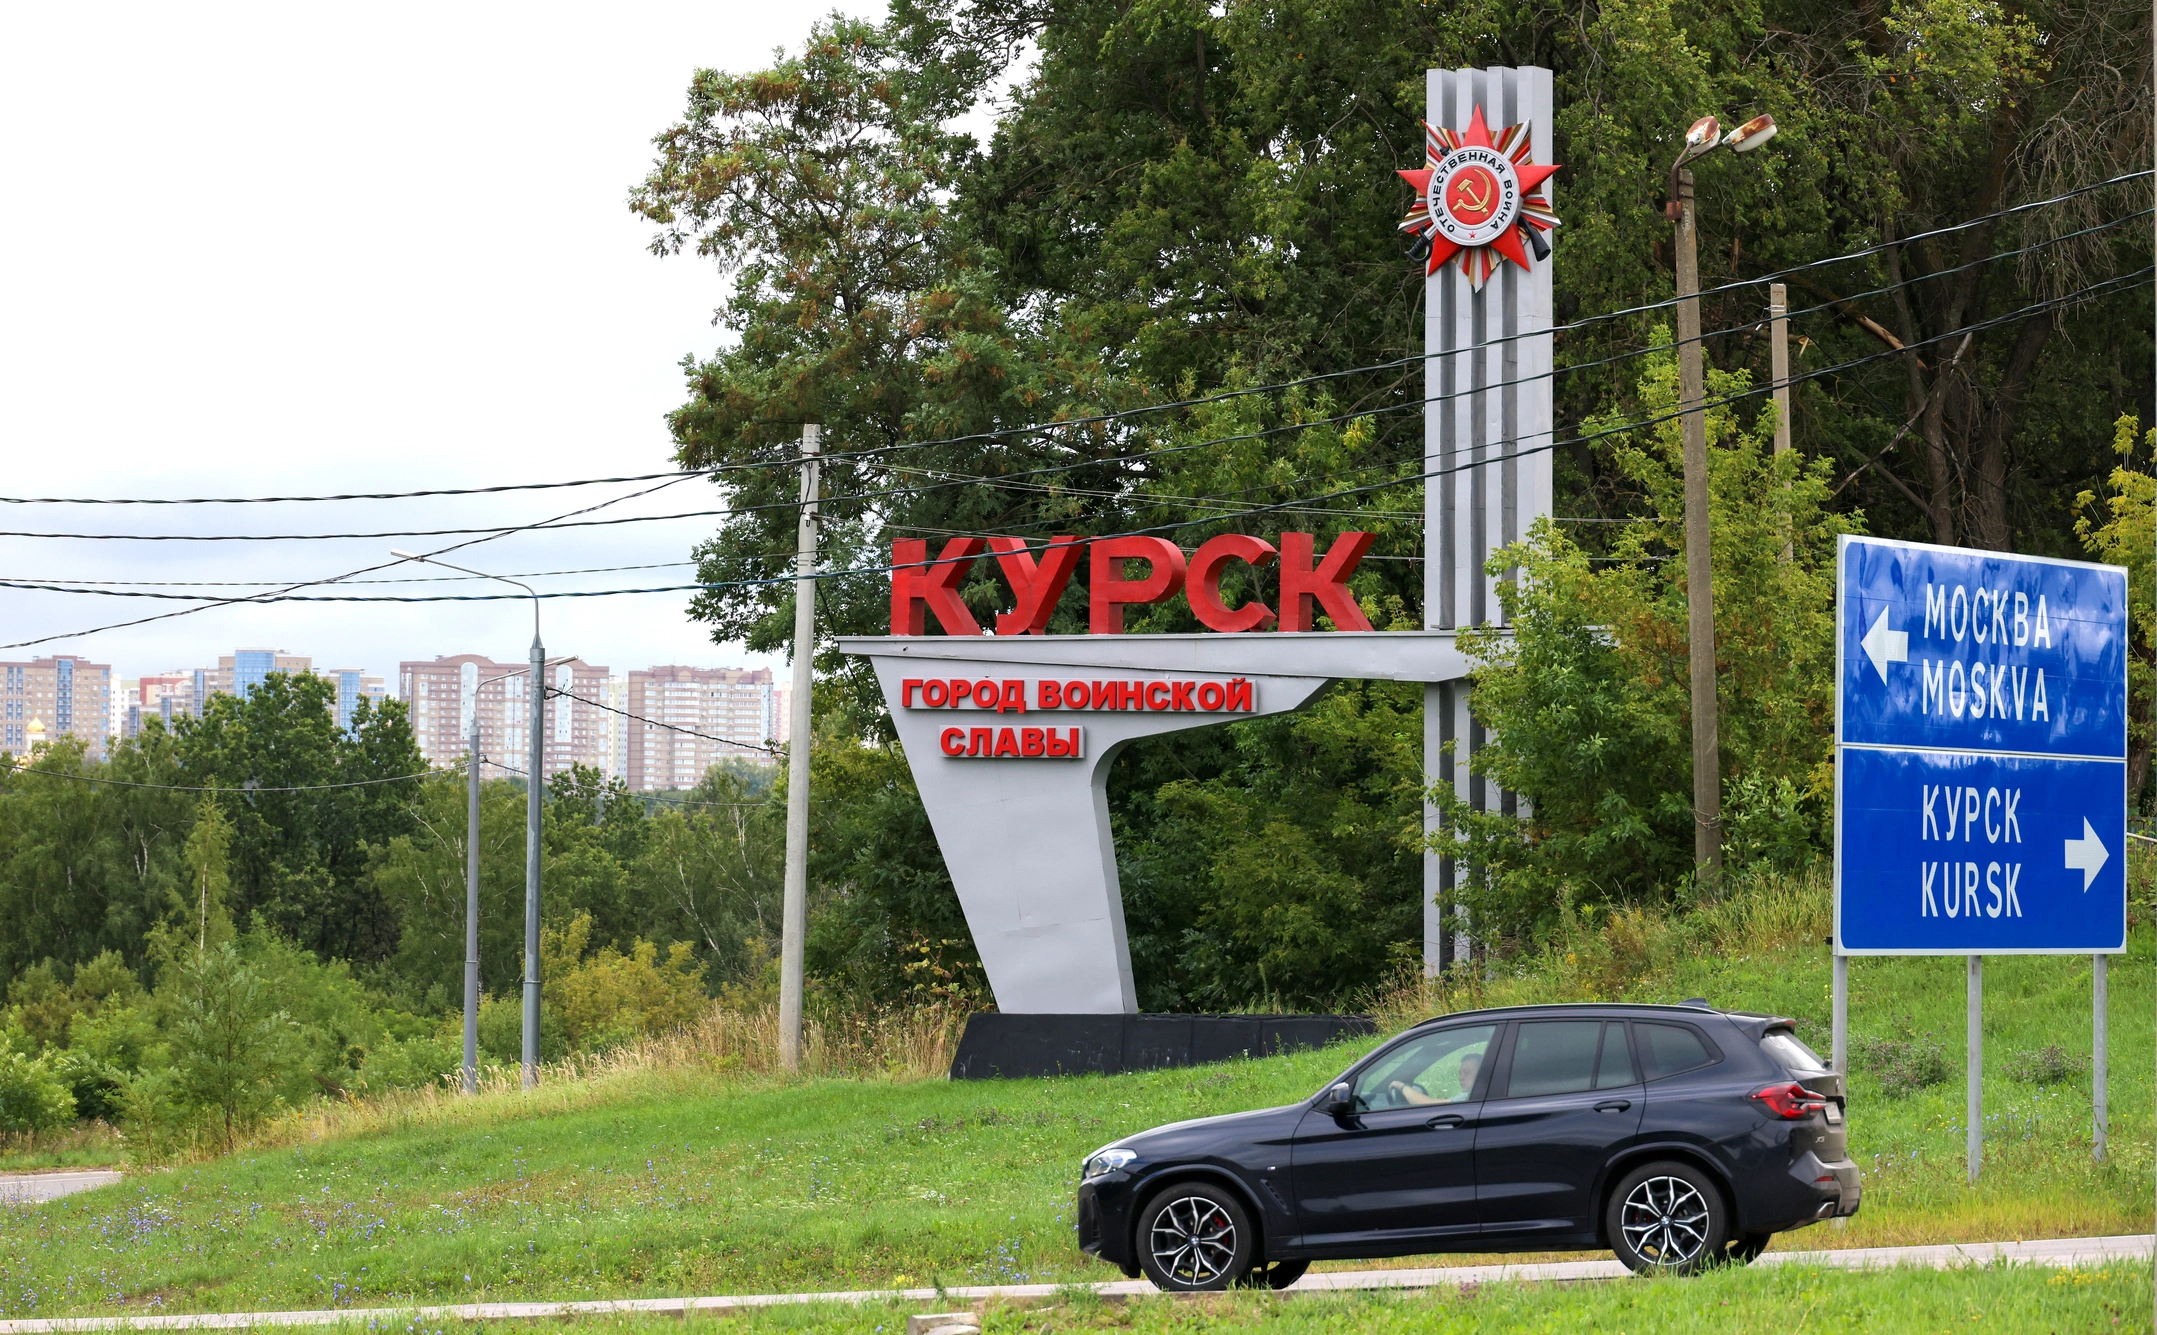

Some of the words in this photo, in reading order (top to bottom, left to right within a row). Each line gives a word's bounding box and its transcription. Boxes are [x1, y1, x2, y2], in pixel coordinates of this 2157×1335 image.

[1432, 151, 1506, 233] ОТЕЧЕСТВЕННАЯ
[891, 531, 1377, 635] КУРСК
[1923, 582, 2051, 649] МОСКВА
[902, 678, 1026, 714] ГОРОД
[1038, 677, 1253, 712] ВОИНСКОЙ
[1922, 659, 2049, 722] MOSKVA
[940, 727, 1079, 758] СЛАВЫ
[1922, 784, 2022, 844] КУРСК
[1921, 861, 2023, 919] KURSK
